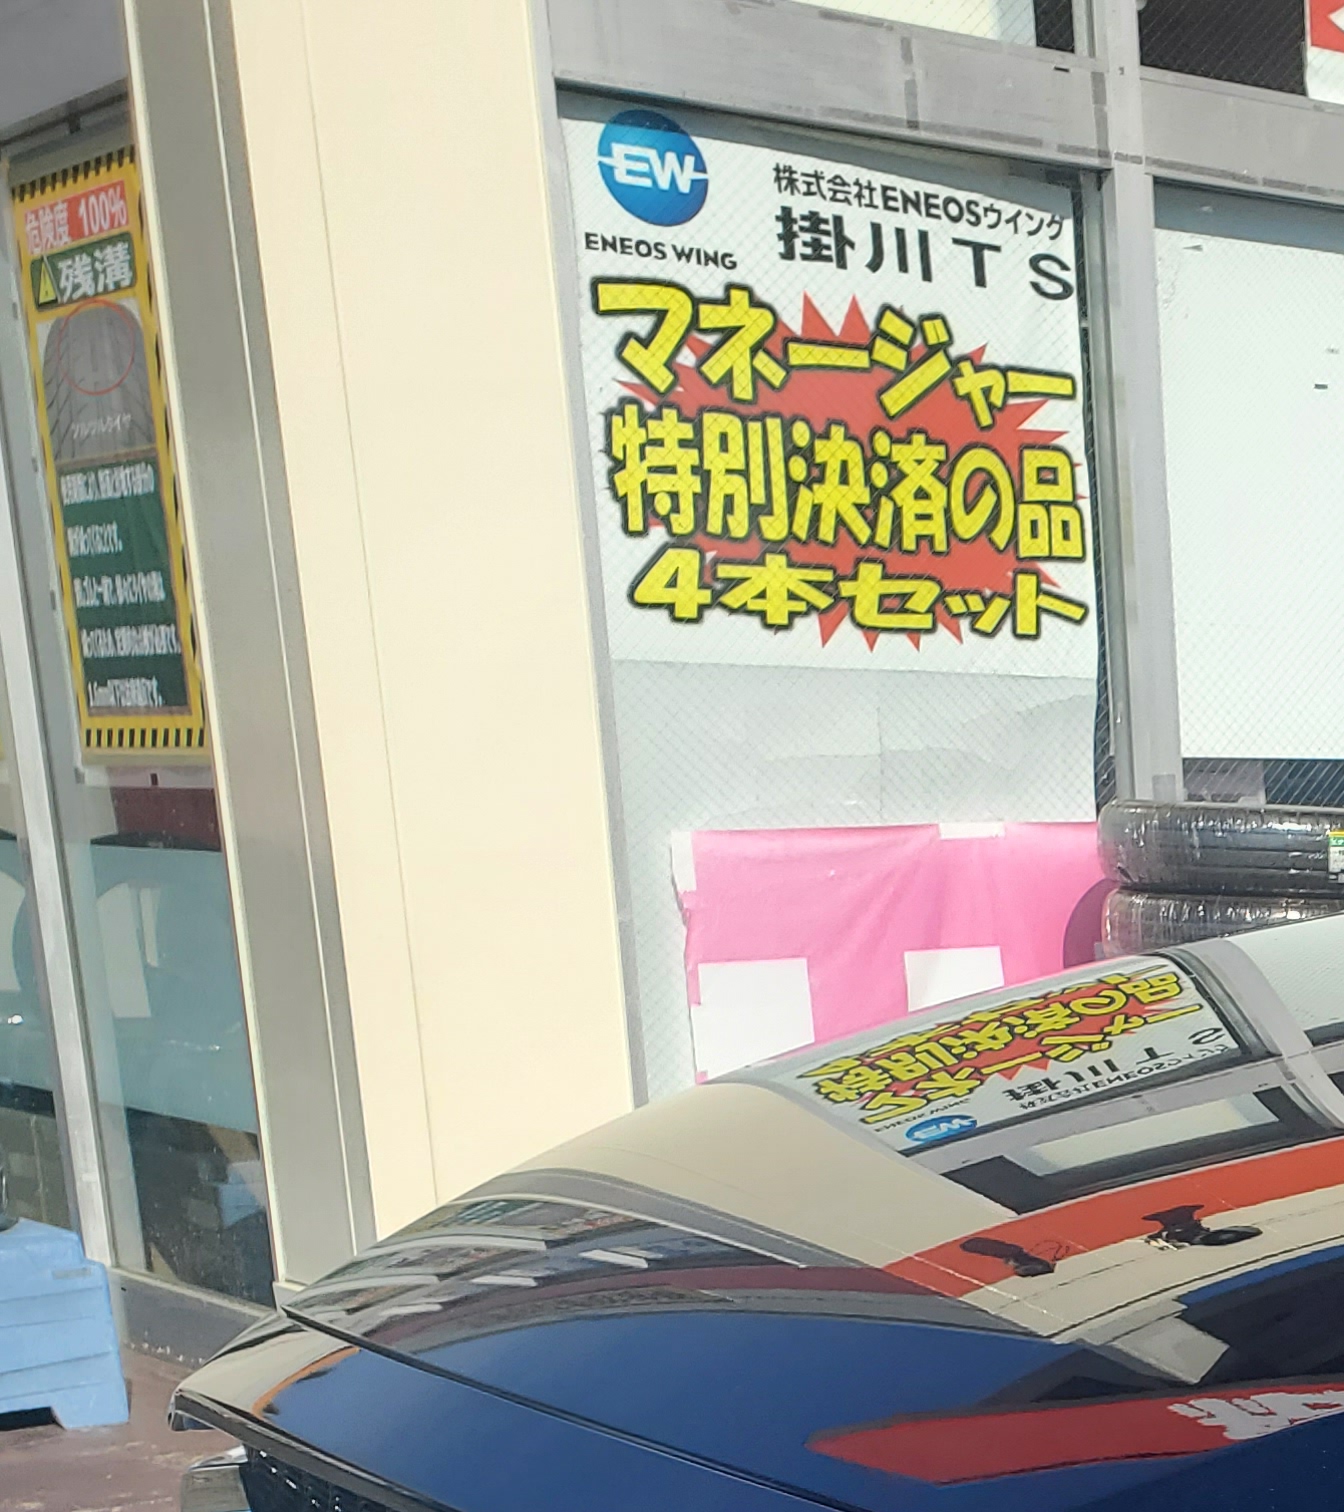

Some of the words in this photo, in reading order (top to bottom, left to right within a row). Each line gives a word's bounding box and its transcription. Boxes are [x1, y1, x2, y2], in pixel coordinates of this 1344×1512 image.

[26, 202, 71, 255] 危険度
[78, 185, 127, 237] 100%
[773, 163, 1065, 241] 株式会社ENEOSウイング
[58, 241, 133, 303] 残溝
[584, 231, 668, 260] ENEOS
[671, 244, 738, 270] WING
[591, 277, 1077, 428] マネージャー
[606, 401, 1087, 561] 特別決済の品
[628, 545, 1088, 639] 4本セット
